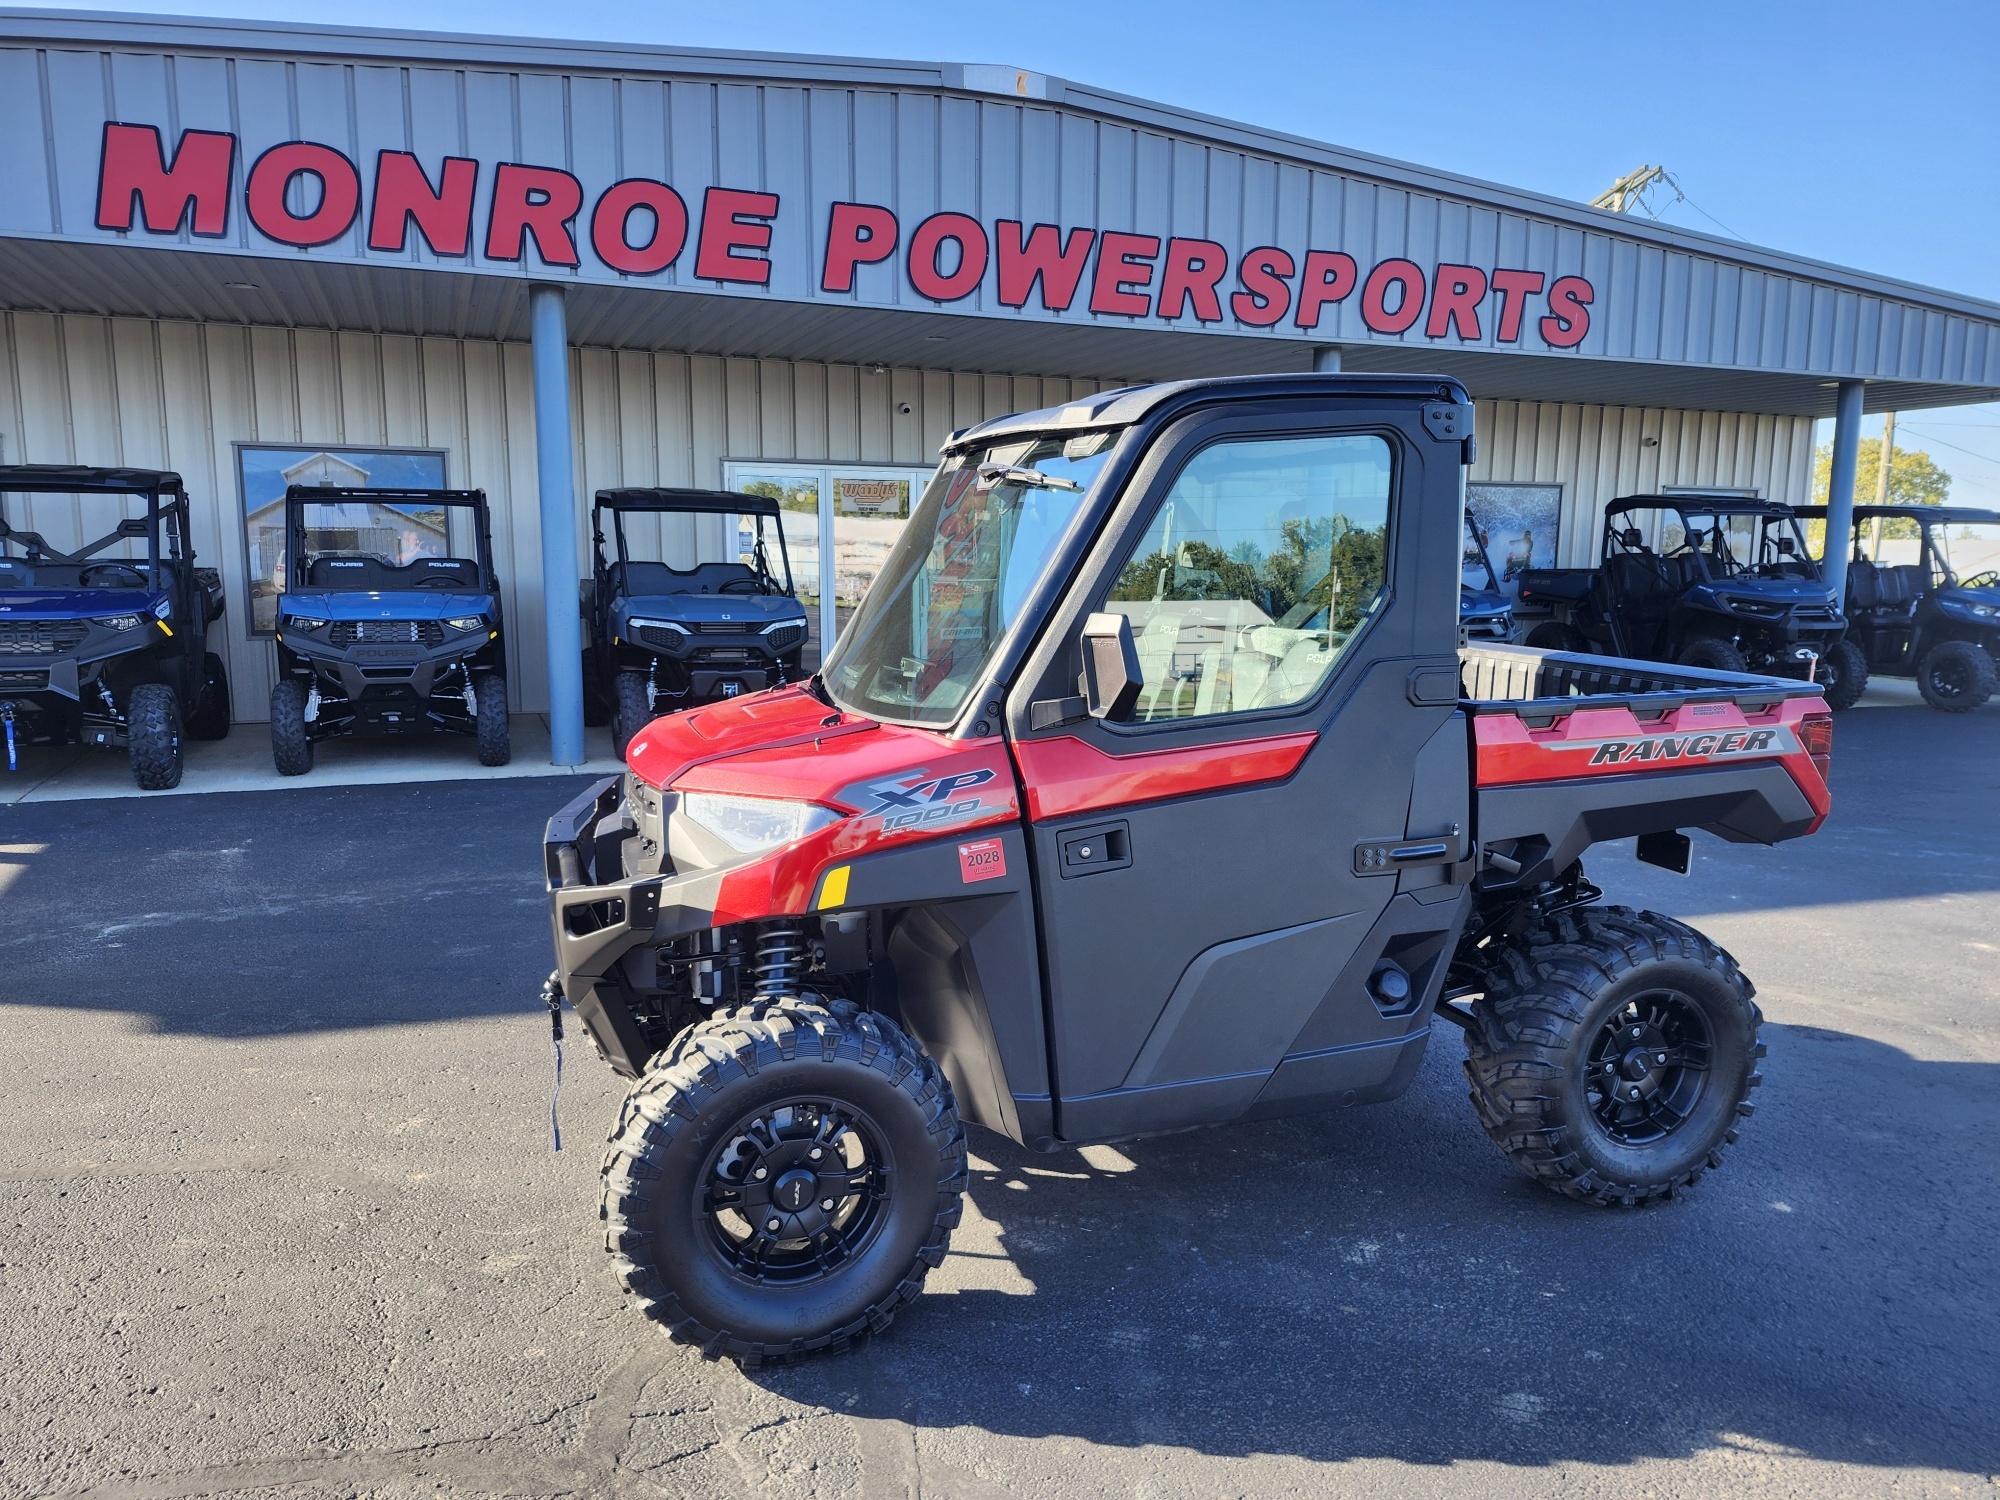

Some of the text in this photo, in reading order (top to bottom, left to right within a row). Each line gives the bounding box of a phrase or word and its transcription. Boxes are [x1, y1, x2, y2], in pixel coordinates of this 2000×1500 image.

[95, 120, 1595, 348] MONROE POWERSPORTS
[356, 649, 418, 657] POLARIS
[1588, 729, 1778, 766] RANGER
[850, 768, 997, 822] XP
[880, 798, 982, 833] 1000
[881, 828, 905, 837] DUAL
[967, 850, 1000, 867] 2028
